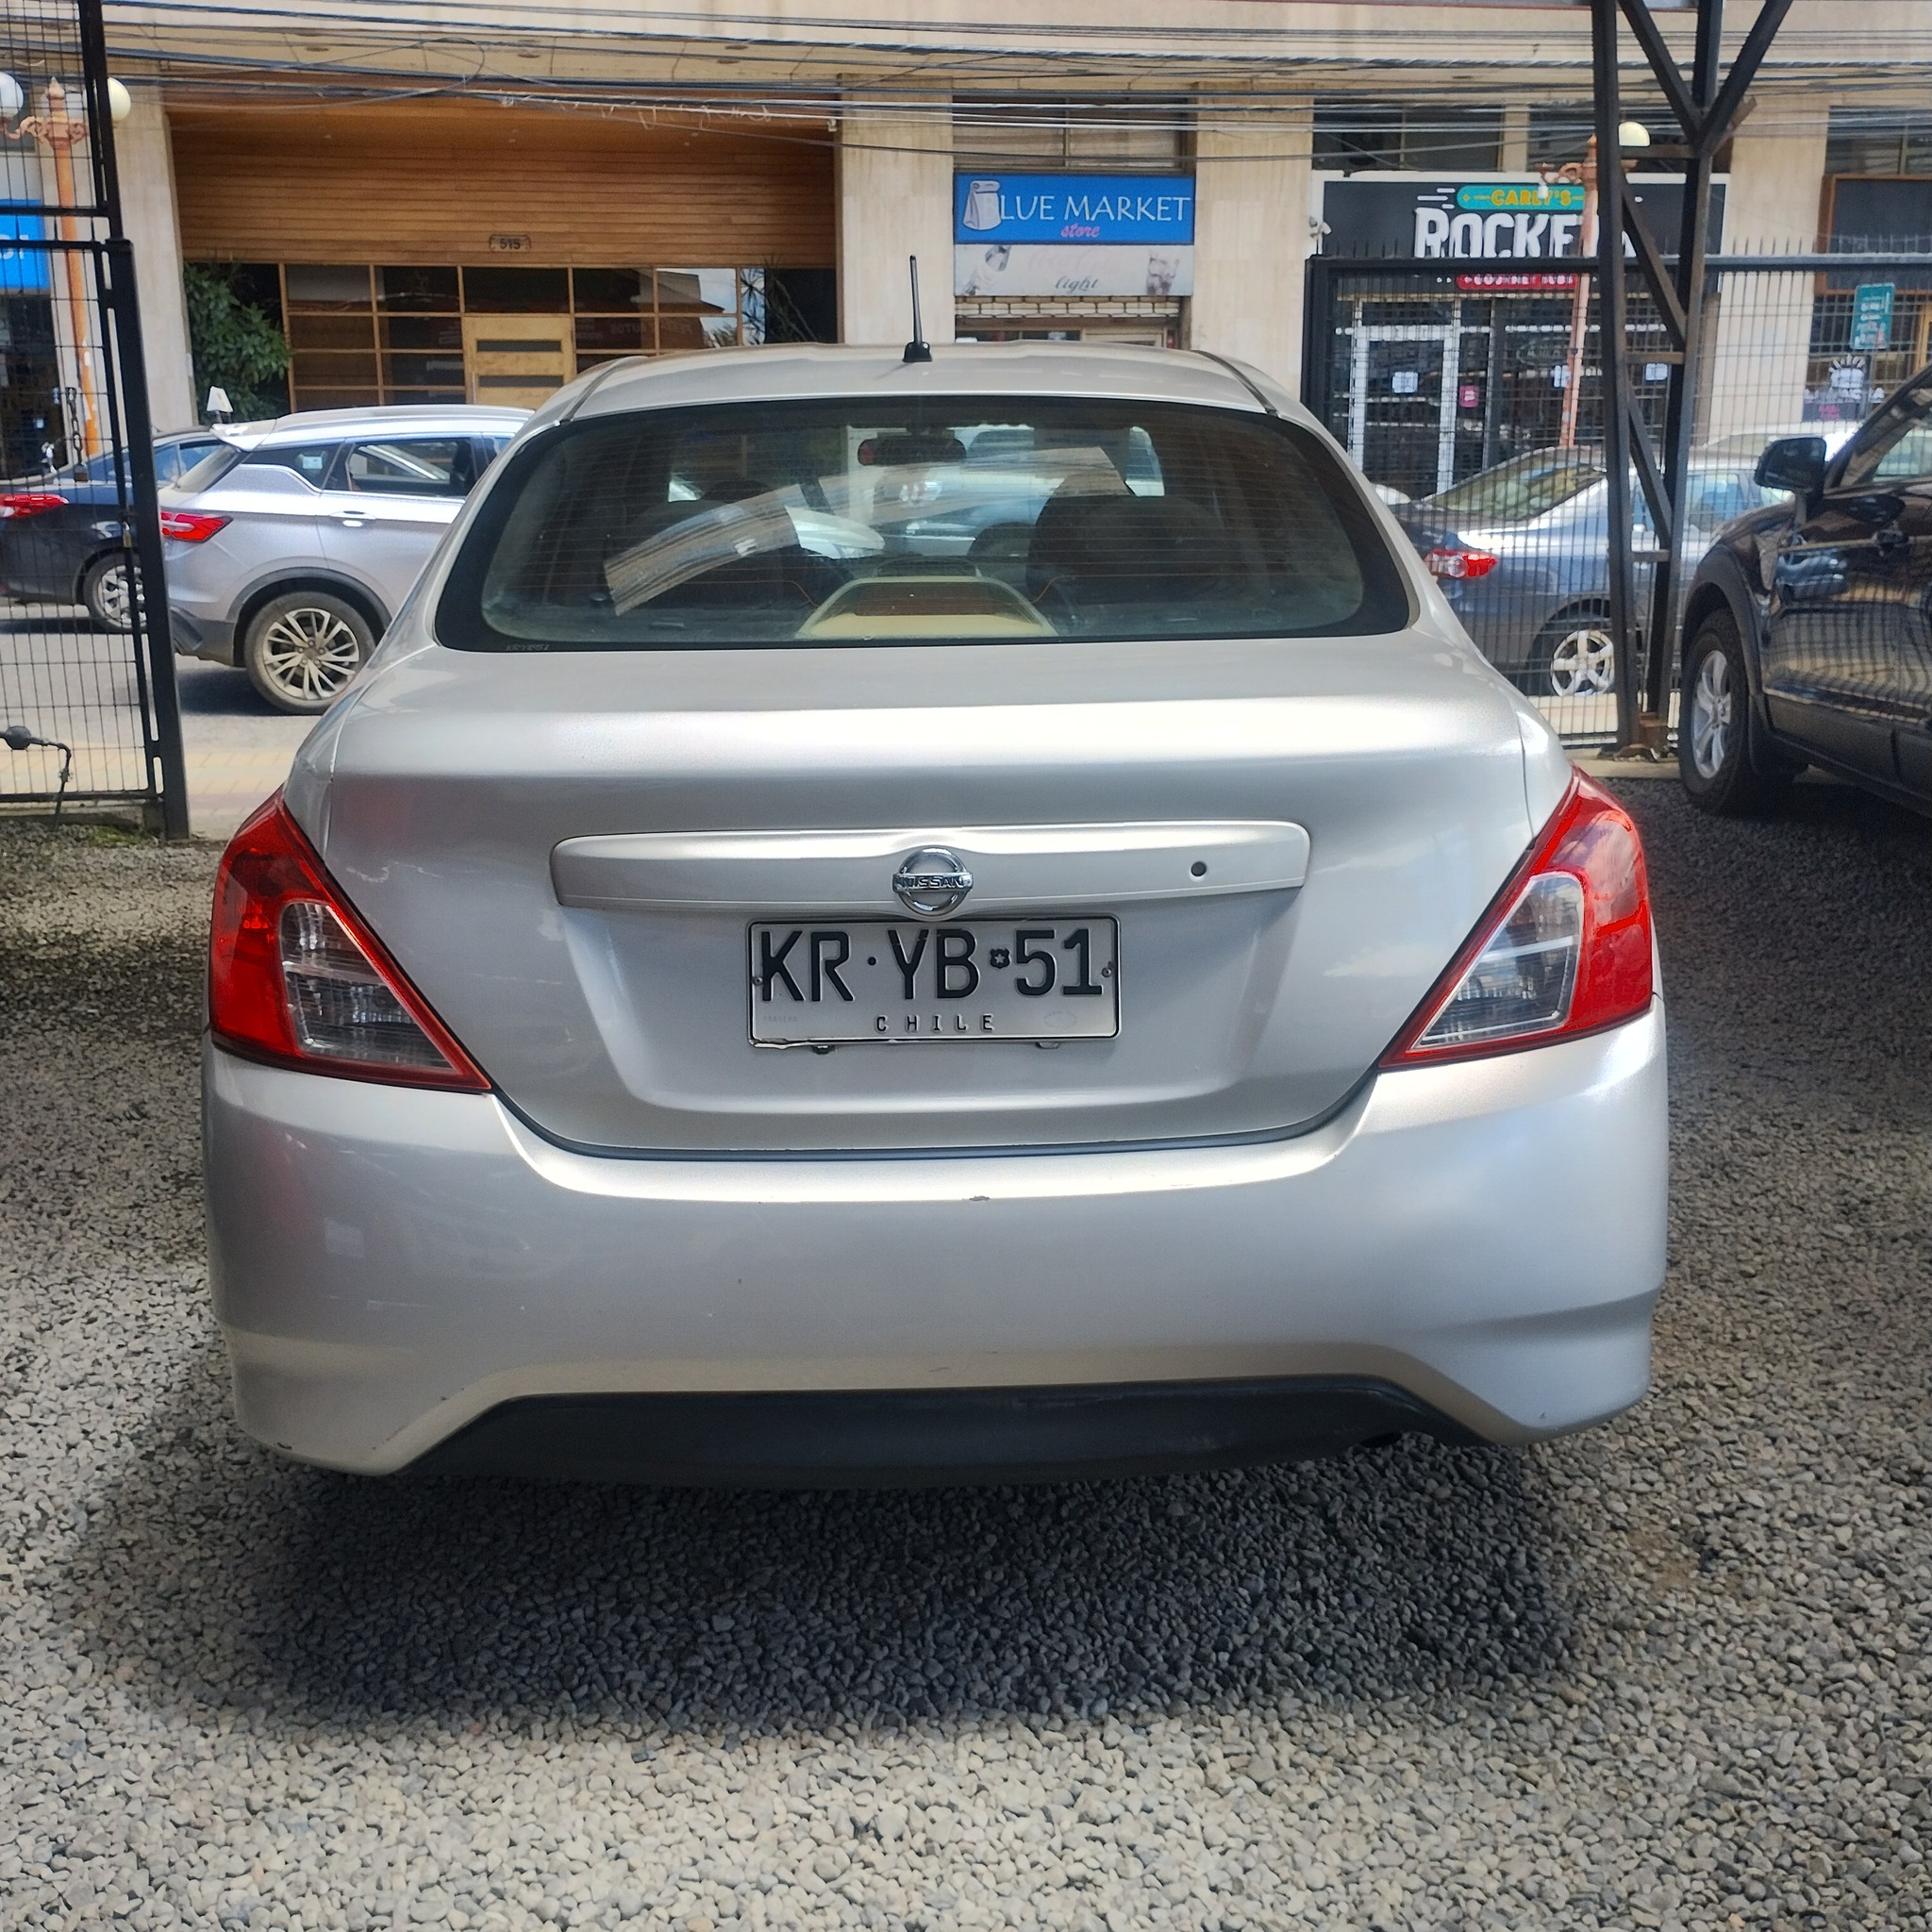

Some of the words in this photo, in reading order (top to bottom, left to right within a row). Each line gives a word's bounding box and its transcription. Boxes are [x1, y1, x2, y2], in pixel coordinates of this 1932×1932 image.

[1064, 196, 1192, 221] MARKET
[1060, 223, 1101, 238] store
[1055, 275, 1099, 294] light
[899, 875, 964, 889] NISSAN
[875, 1014, 995, 1033] CHILE
